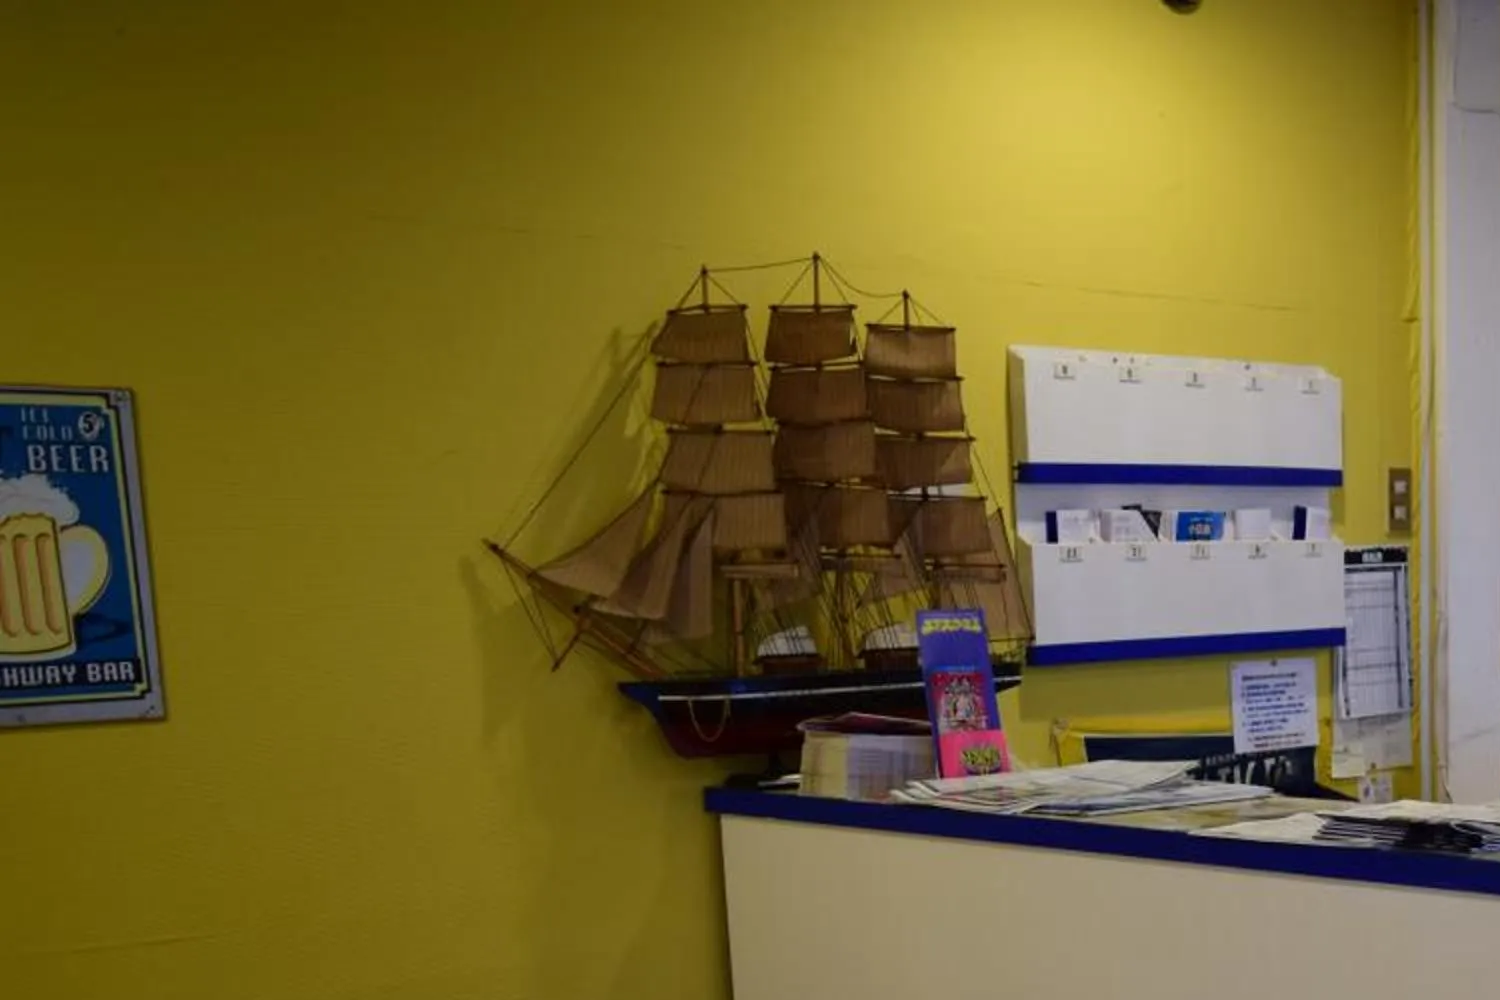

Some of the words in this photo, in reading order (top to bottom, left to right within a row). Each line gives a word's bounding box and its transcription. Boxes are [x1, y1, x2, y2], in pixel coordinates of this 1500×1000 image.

[26, 443, 110, 473] BEER
[0, 663, 77, 688] HWAY
[86, 661, 136, 683] BAR
